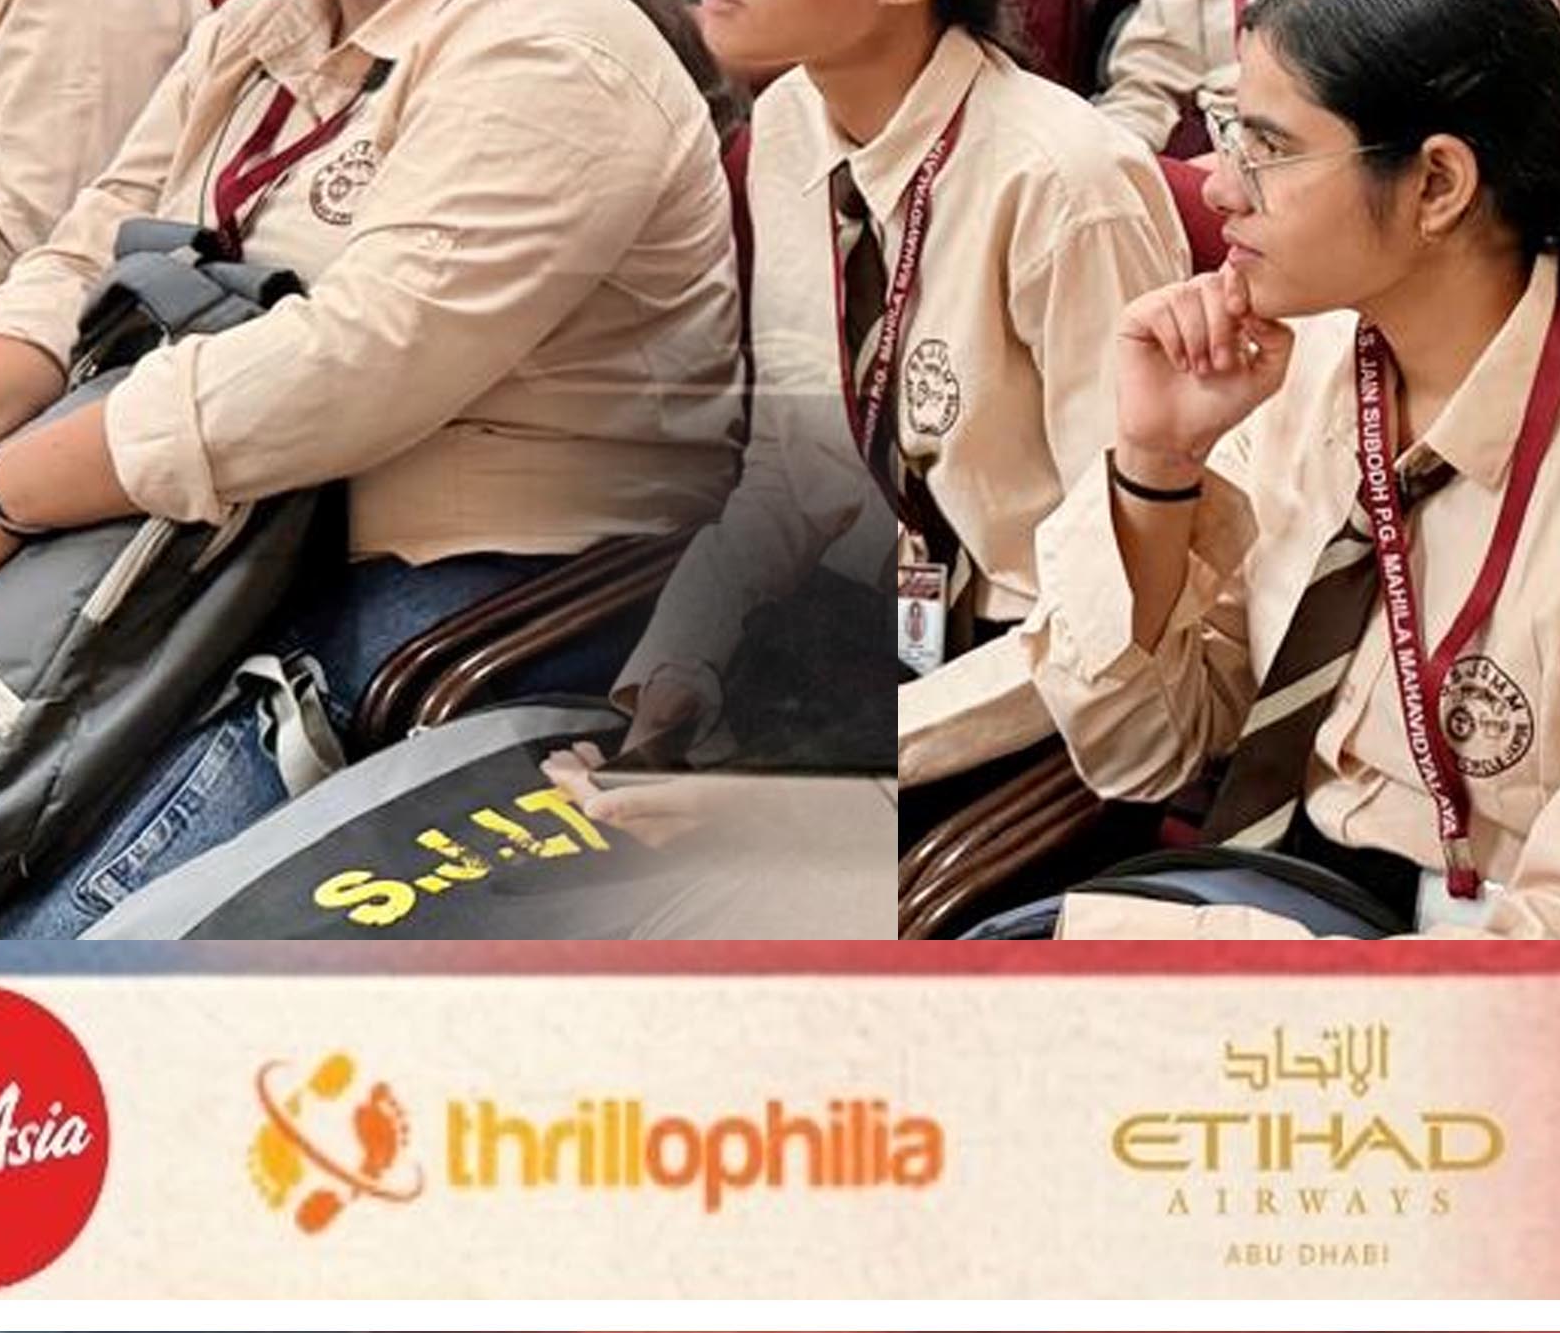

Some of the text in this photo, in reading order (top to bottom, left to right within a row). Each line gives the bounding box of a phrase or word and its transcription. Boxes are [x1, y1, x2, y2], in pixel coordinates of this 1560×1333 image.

[1360, 357, 1381, 403] JAIN
[1362, 407, 1390, 503] SUBODH
[1374, 506, 1398, 550] P.G.
[1381, 552, 1413, 645] MAHILA
[1395, 645, 1459, 840] MAHAVIDYALAYA
